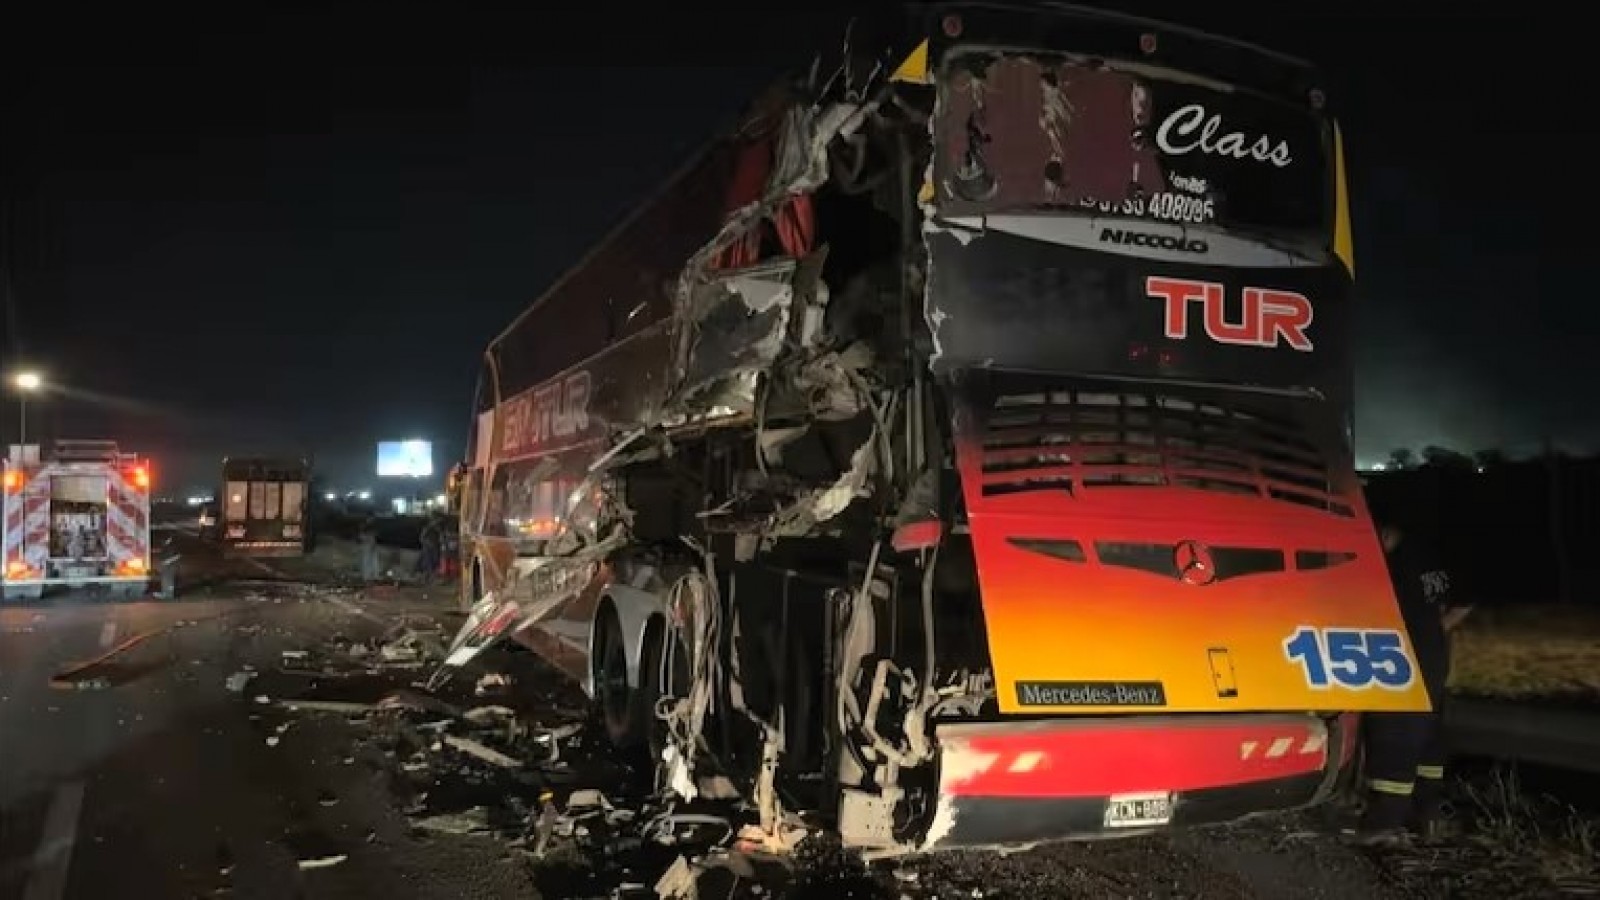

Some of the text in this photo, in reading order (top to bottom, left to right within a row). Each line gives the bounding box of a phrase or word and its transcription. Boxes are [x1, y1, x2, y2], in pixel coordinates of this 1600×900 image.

[1156, 104, 1292, 168] Class
[1145, 275, 1314, 353] TUR
[1282, 626, 1413, 690] 155
[1022, 683, 1160, 705] Mercedes-Benz
